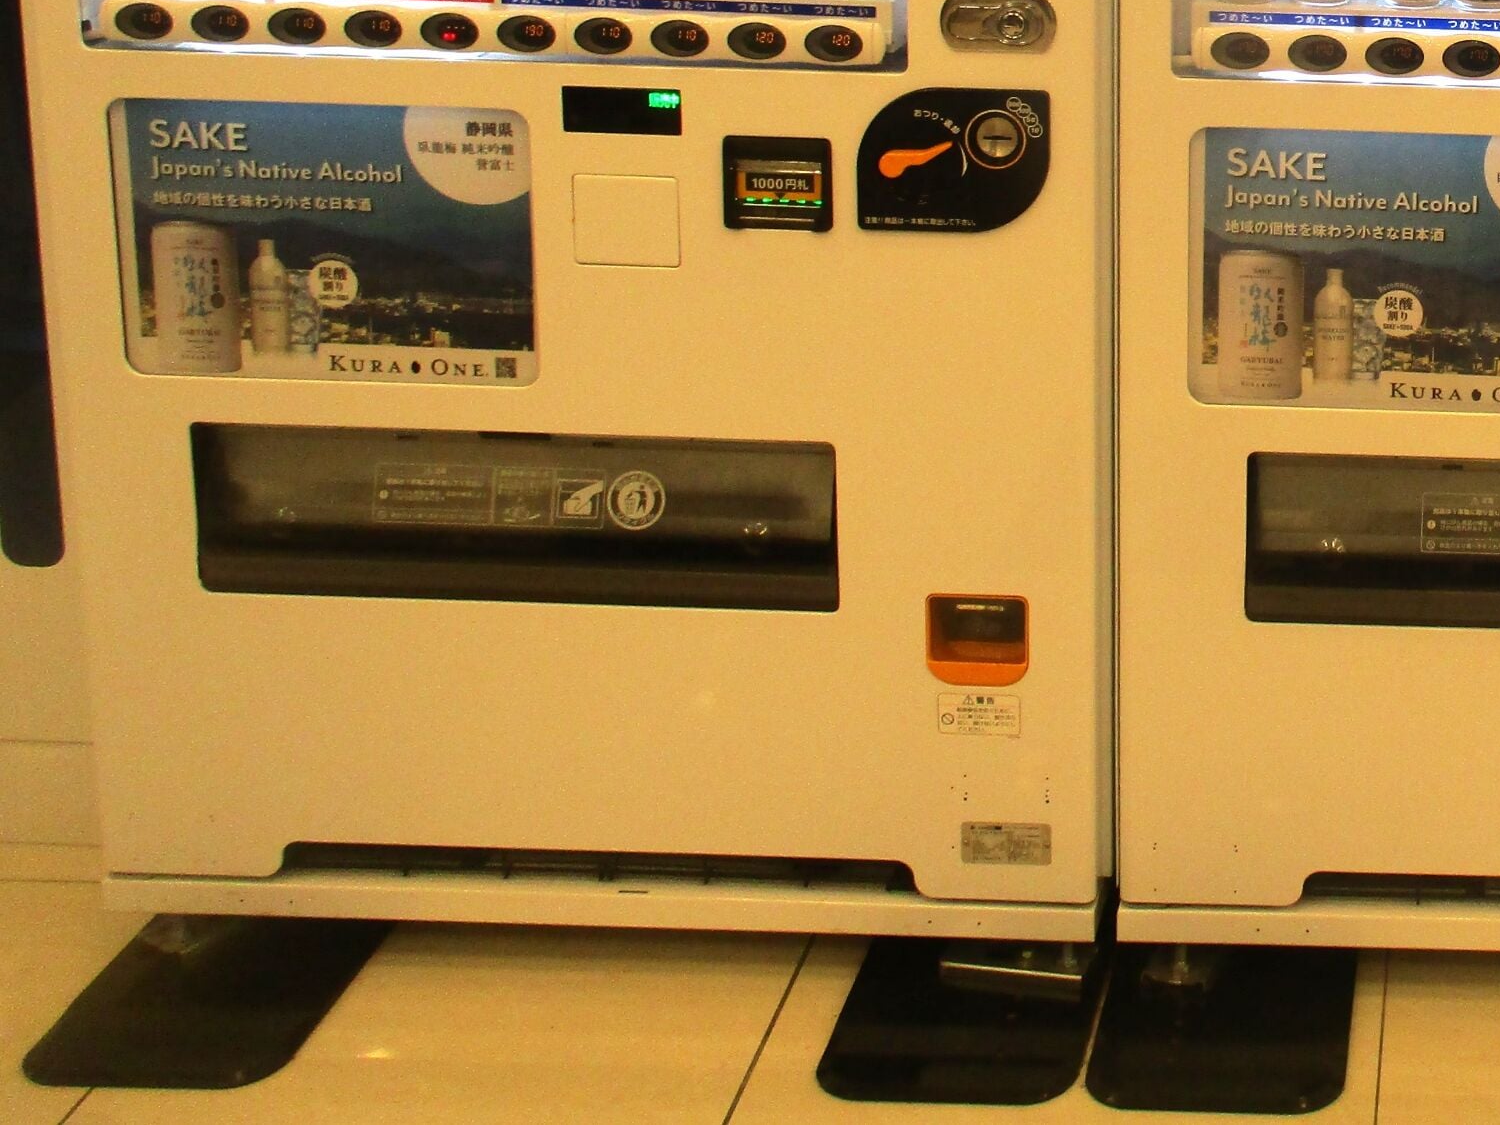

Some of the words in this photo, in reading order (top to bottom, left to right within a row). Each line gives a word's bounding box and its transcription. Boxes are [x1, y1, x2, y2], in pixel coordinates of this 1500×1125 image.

[526, 24, 544, 37] 190
[756, 31, 774, 44] 120
[832, 34, 851, 47] 120
[148, 118, 248, 151] SAKE
[466, 121, 513, 138] 静岡県
[238, 160, 312, 181] Native
[317, 163, 403, 183] Alcohol
[1226, 147, 1327, 181] SAKE
[751, 176, 809, 192] 1000円札
[1315, 190, 1387, 211] Native
[1393, 192, 1480, 214] Alcohol
[1225, 219, 1445, 242] 地域の個性を味わう小さな日本酒
[318, 266, 349, 282] 炭酸
[1384, 296, 1413, 311] 炭酸
[1387, 310, 1408, 322] 割り
[329, 354, 403, 374] KURA
[1389, 382, 1463, 402] KURA
